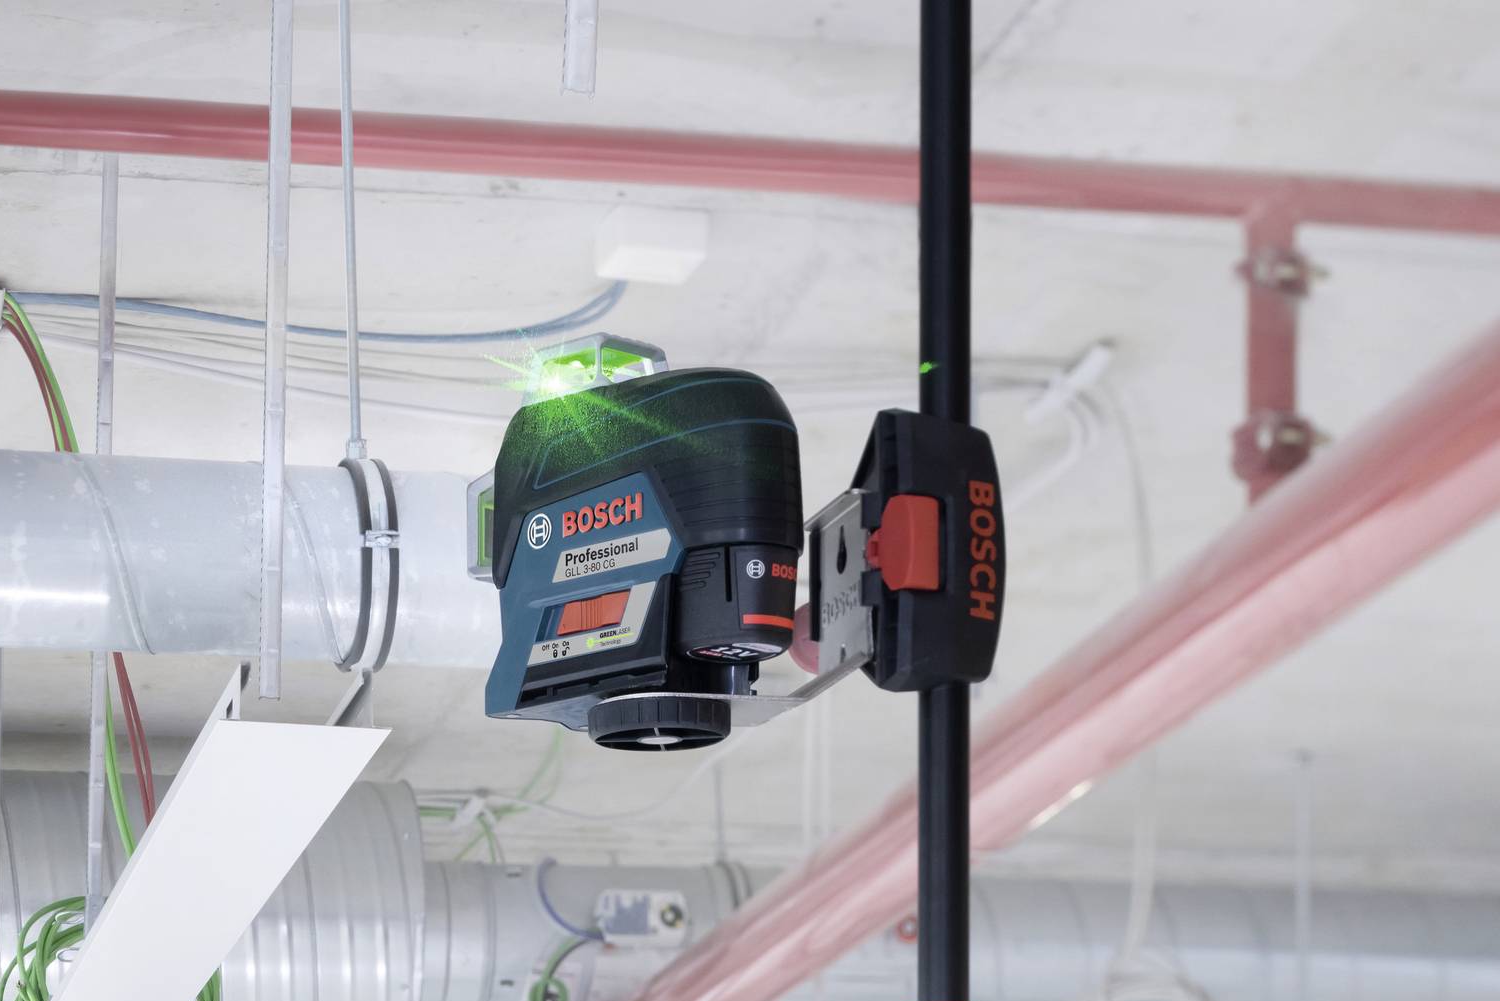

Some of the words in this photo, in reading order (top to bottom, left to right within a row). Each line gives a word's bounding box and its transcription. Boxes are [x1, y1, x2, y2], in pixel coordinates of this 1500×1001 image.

[562, 491, 643, 538] BOSCH
[565, 537, 639, 566] Professional
[969, 479, 996, 621] BOSCH
[565, 567, 581, 578] GLL
[583, 561, 601, 574] 3-80
[603, 558, 616, 569] CG
[541, 643, 550, 652] Off
[551, 642, 559, 650] On
[710, 646, 759, 658] 12V
